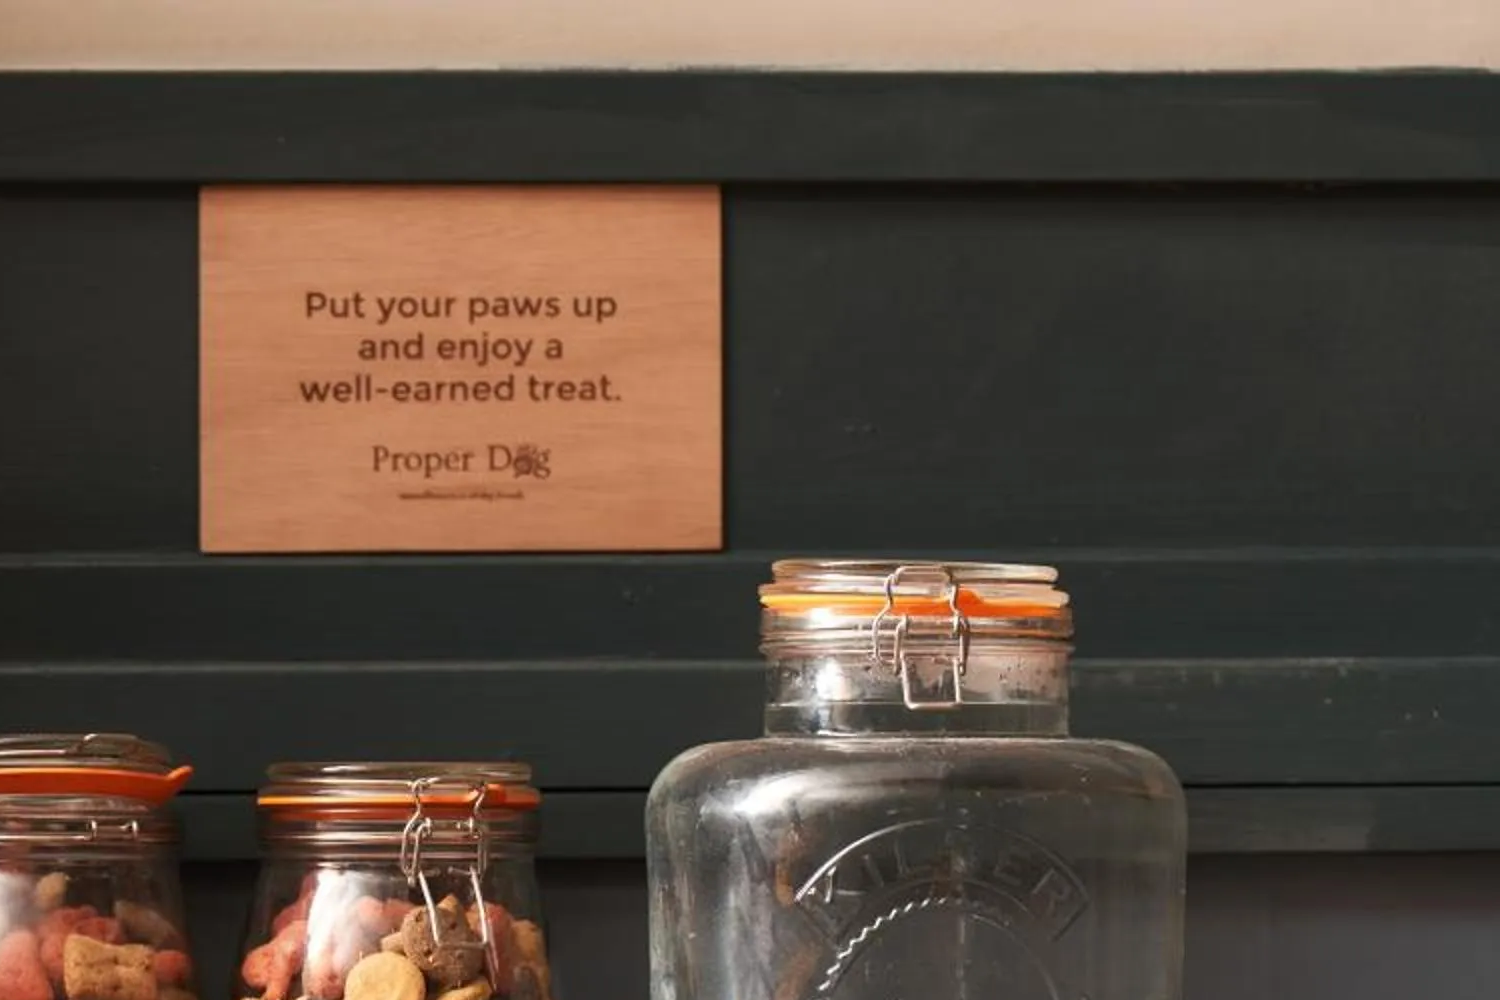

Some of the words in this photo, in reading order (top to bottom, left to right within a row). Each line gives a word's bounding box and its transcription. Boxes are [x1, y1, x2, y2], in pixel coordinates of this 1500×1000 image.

[304, 290, 366, 320] Put
[376, 296, 457, 326] your
[468, 296, 561, 325] paws
[572, 296, 618, 325] up
[357, 331, 425, 361] and
[436, 331, 534, 368] enjoy
[544, 338, 564, 360] a
[299, 373, 515, 404] well-earned
[527, 374, 622, 403] treat.
[372, 445, 475, 479] Proper
[487, 443, 552, 480] Dog
[803, 832, 1075, 935] KILER
